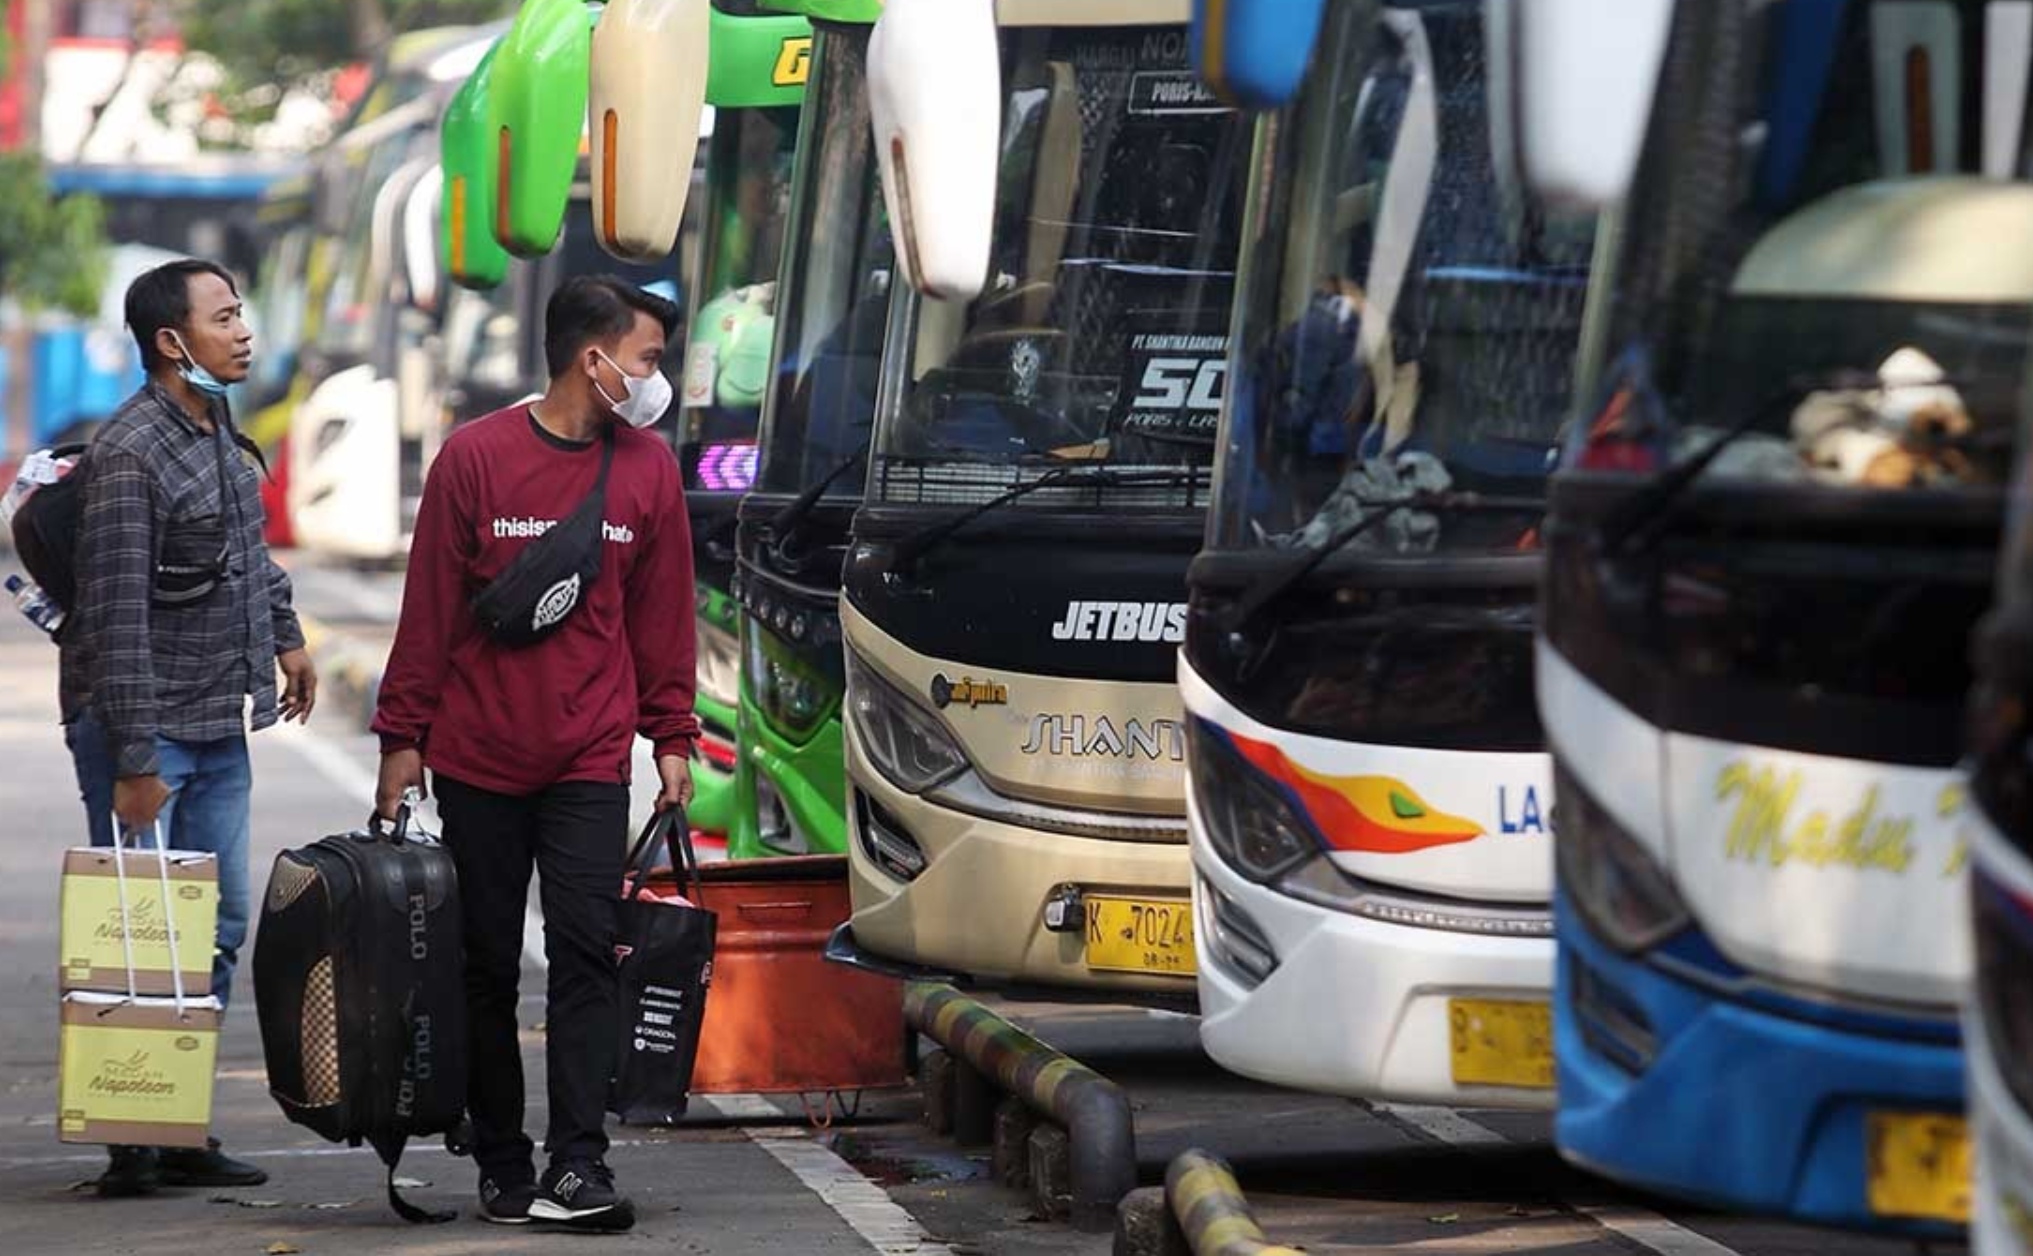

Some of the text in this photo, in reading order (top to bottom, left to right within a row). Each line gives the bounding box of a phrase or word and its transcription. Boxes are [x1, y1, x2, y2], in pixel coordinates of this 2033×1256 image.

[410, 894, 427, 960] POLO
[1088, 902, 1103, 944] K
[415, 1014, 432, 1080] POLO
[88, 1074, 176, 1098] Napoleon
